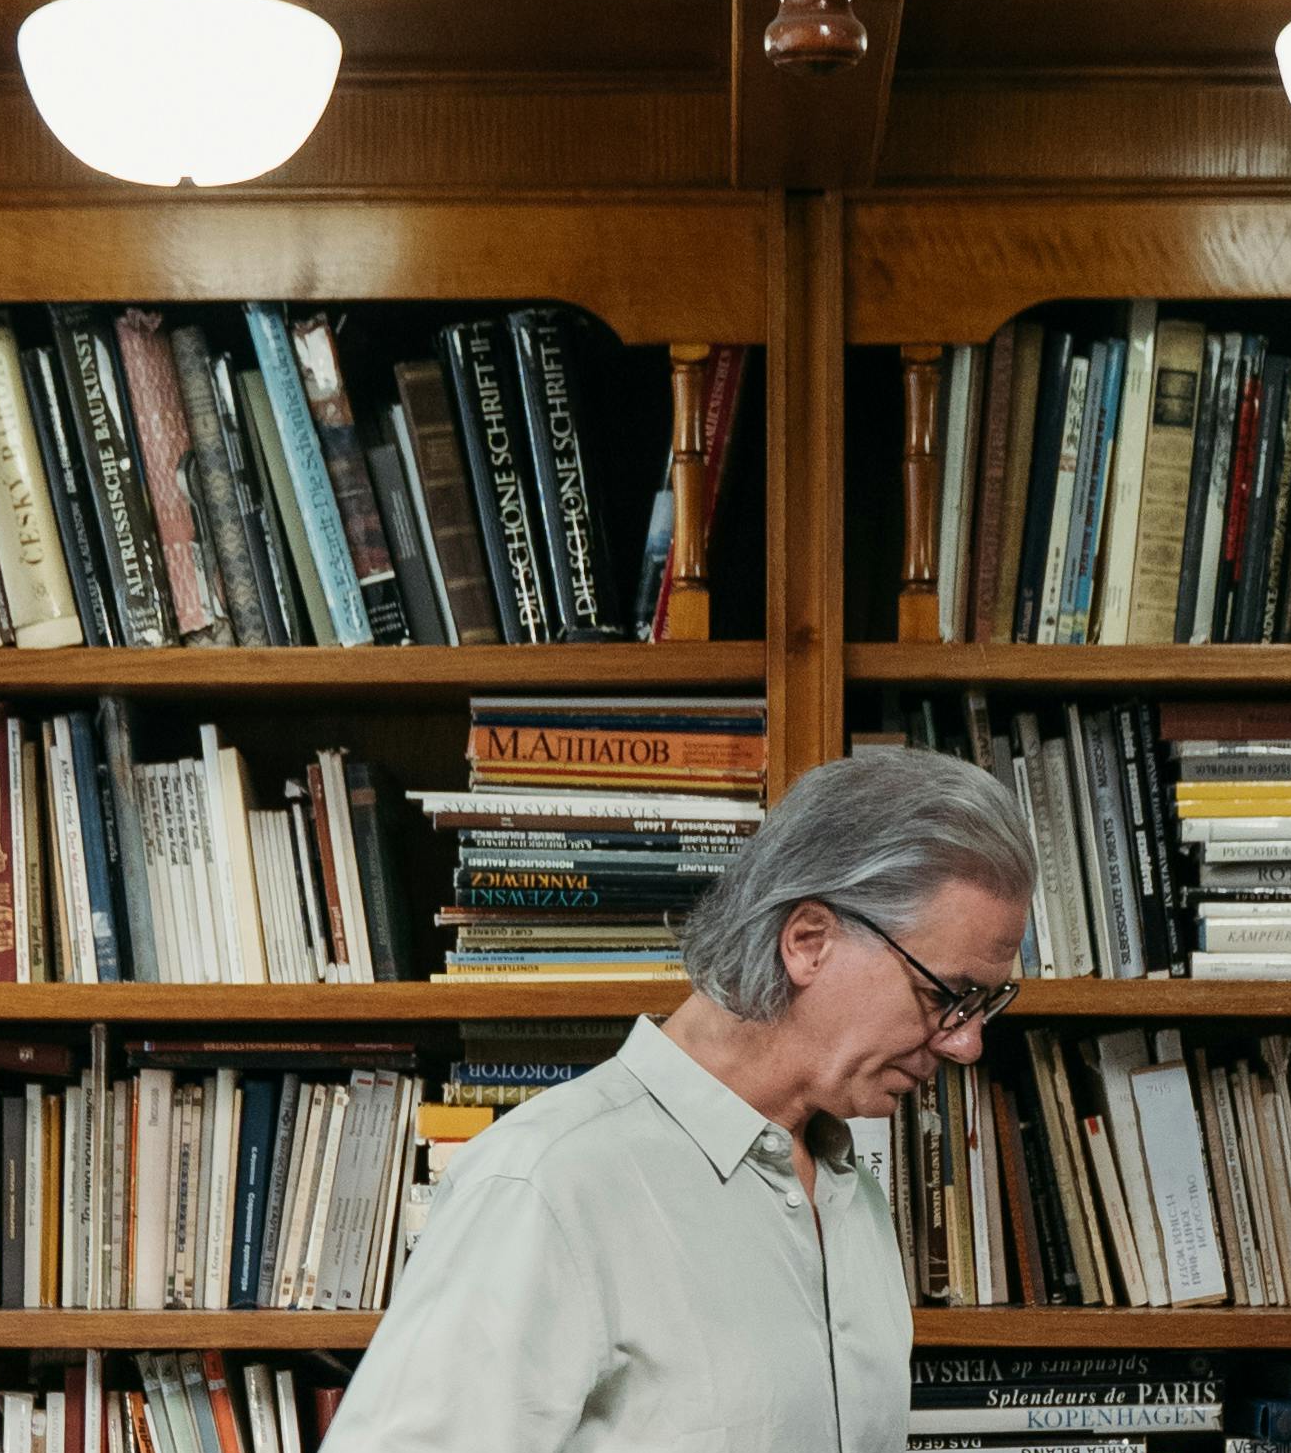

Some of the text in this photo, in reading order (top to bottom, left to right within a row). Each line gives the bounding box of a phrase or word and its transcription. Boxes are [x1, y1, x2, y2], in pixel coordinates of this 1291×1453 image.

[69, 332, 148, 599] ALTRUSSISCHE BAUKUNST
[491, 468, 543, 625] DIE SCHÖNE
[553, 455, 598, 615] DIE SCHÖNE
[1102, 817, 1119, 861] ORIENTS
[470, 872, 587, 889] PANKIEWICZ
[1107, 863, 1122, 883] DES
[1011, 1355, 1148, 1374] Splendeurs de
[987, 1381, 1216, 1407] Splendeurs de PARIS
[1027, 1405, 1207, 1428] KOPENHAGEN
